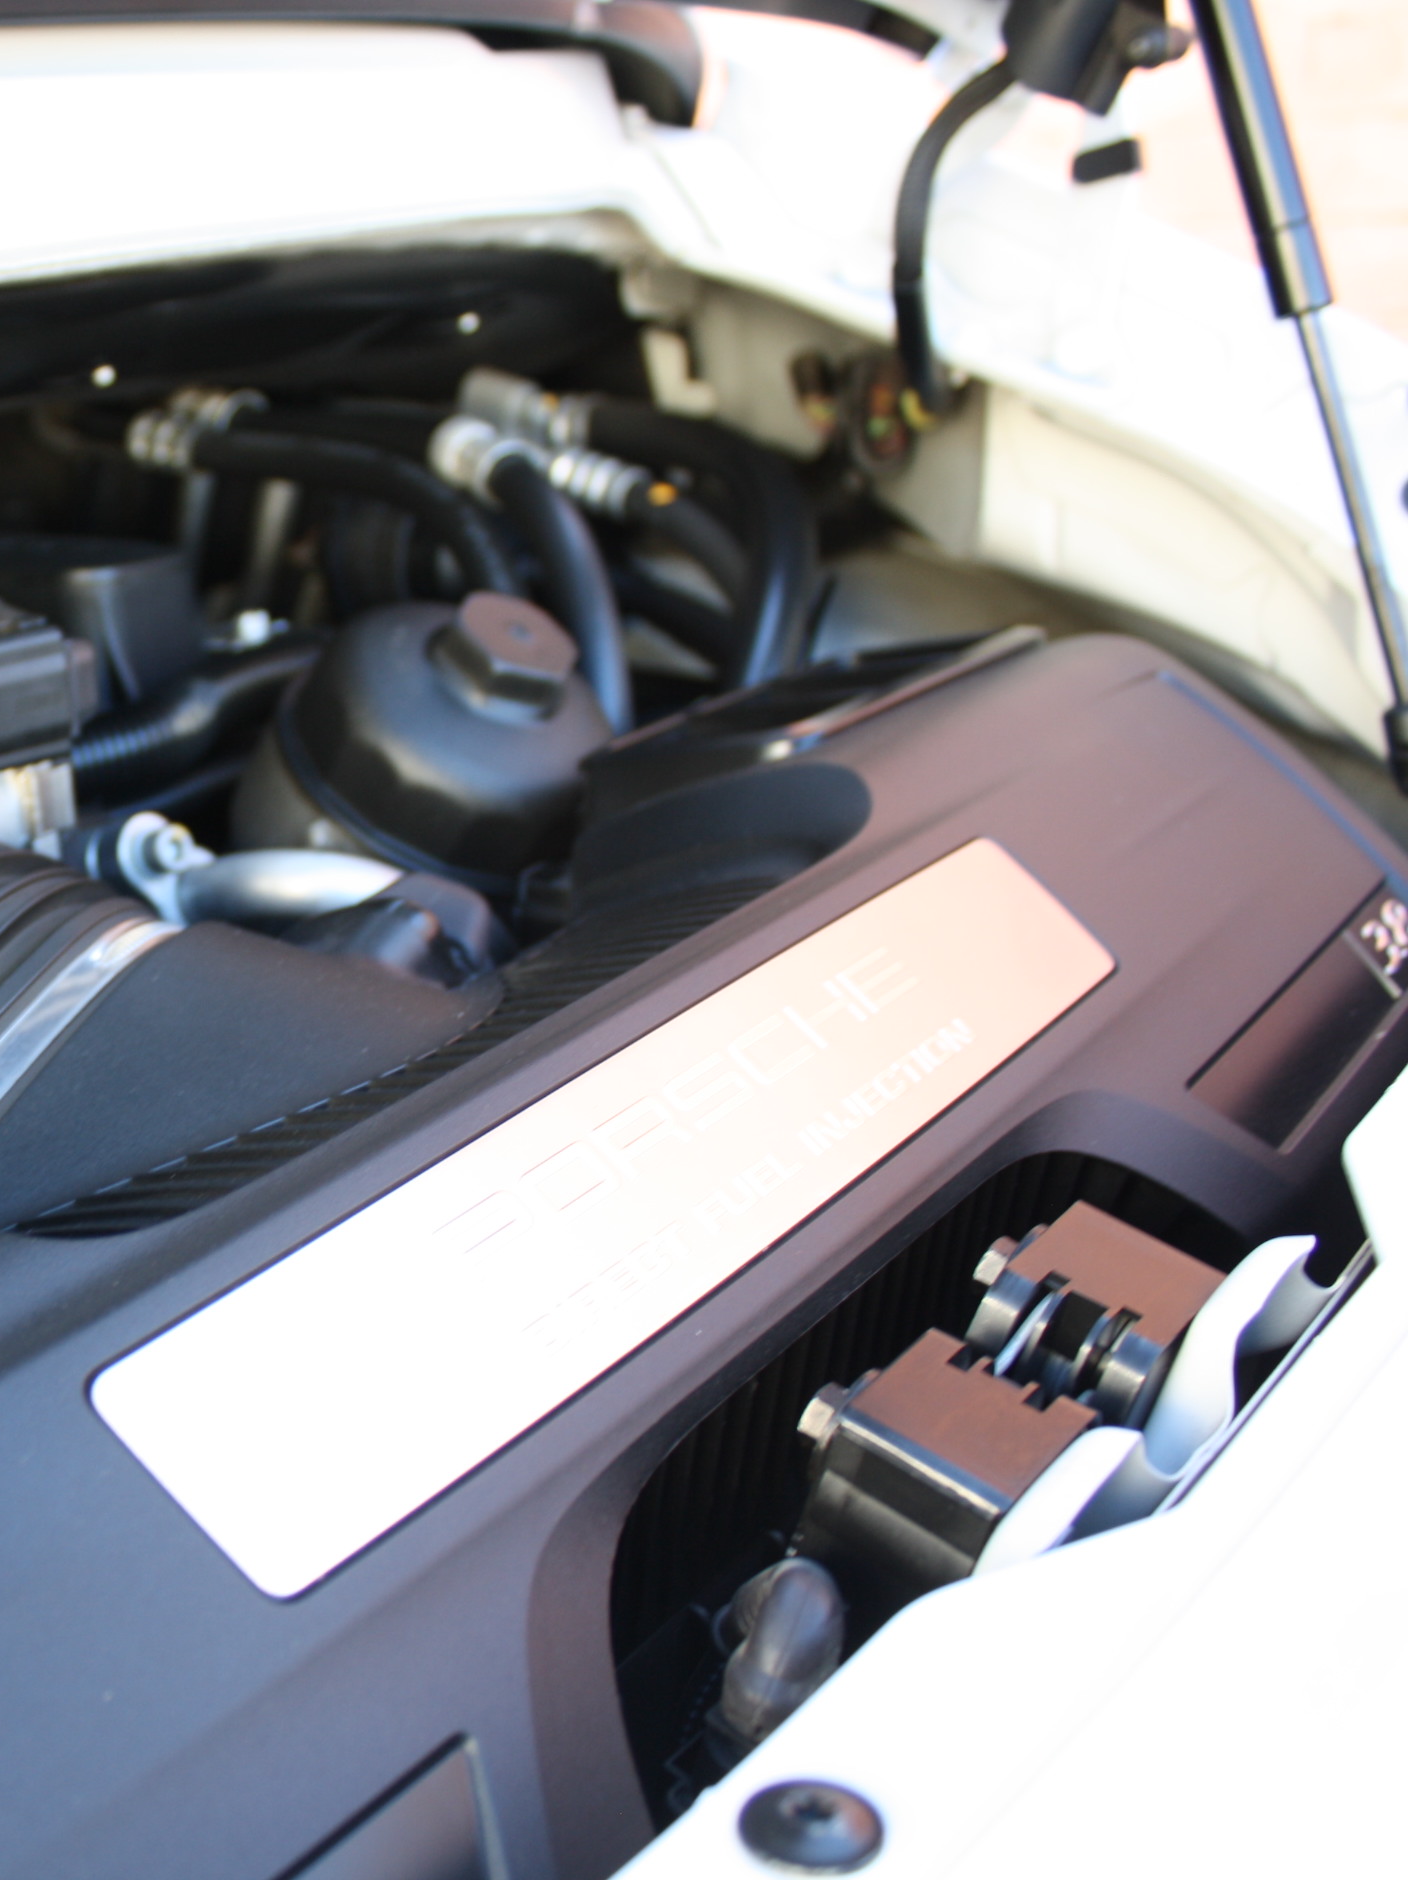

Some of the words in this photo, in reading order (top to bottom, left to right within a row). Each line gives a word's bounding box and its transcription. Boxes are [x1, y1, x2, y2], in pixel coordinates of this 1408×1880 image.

[430, 944, 922, 1284] PORSCHE
[691, 1151, 806, 1238] FUEL
[797, 1017, 978, 1158] INJECTION
